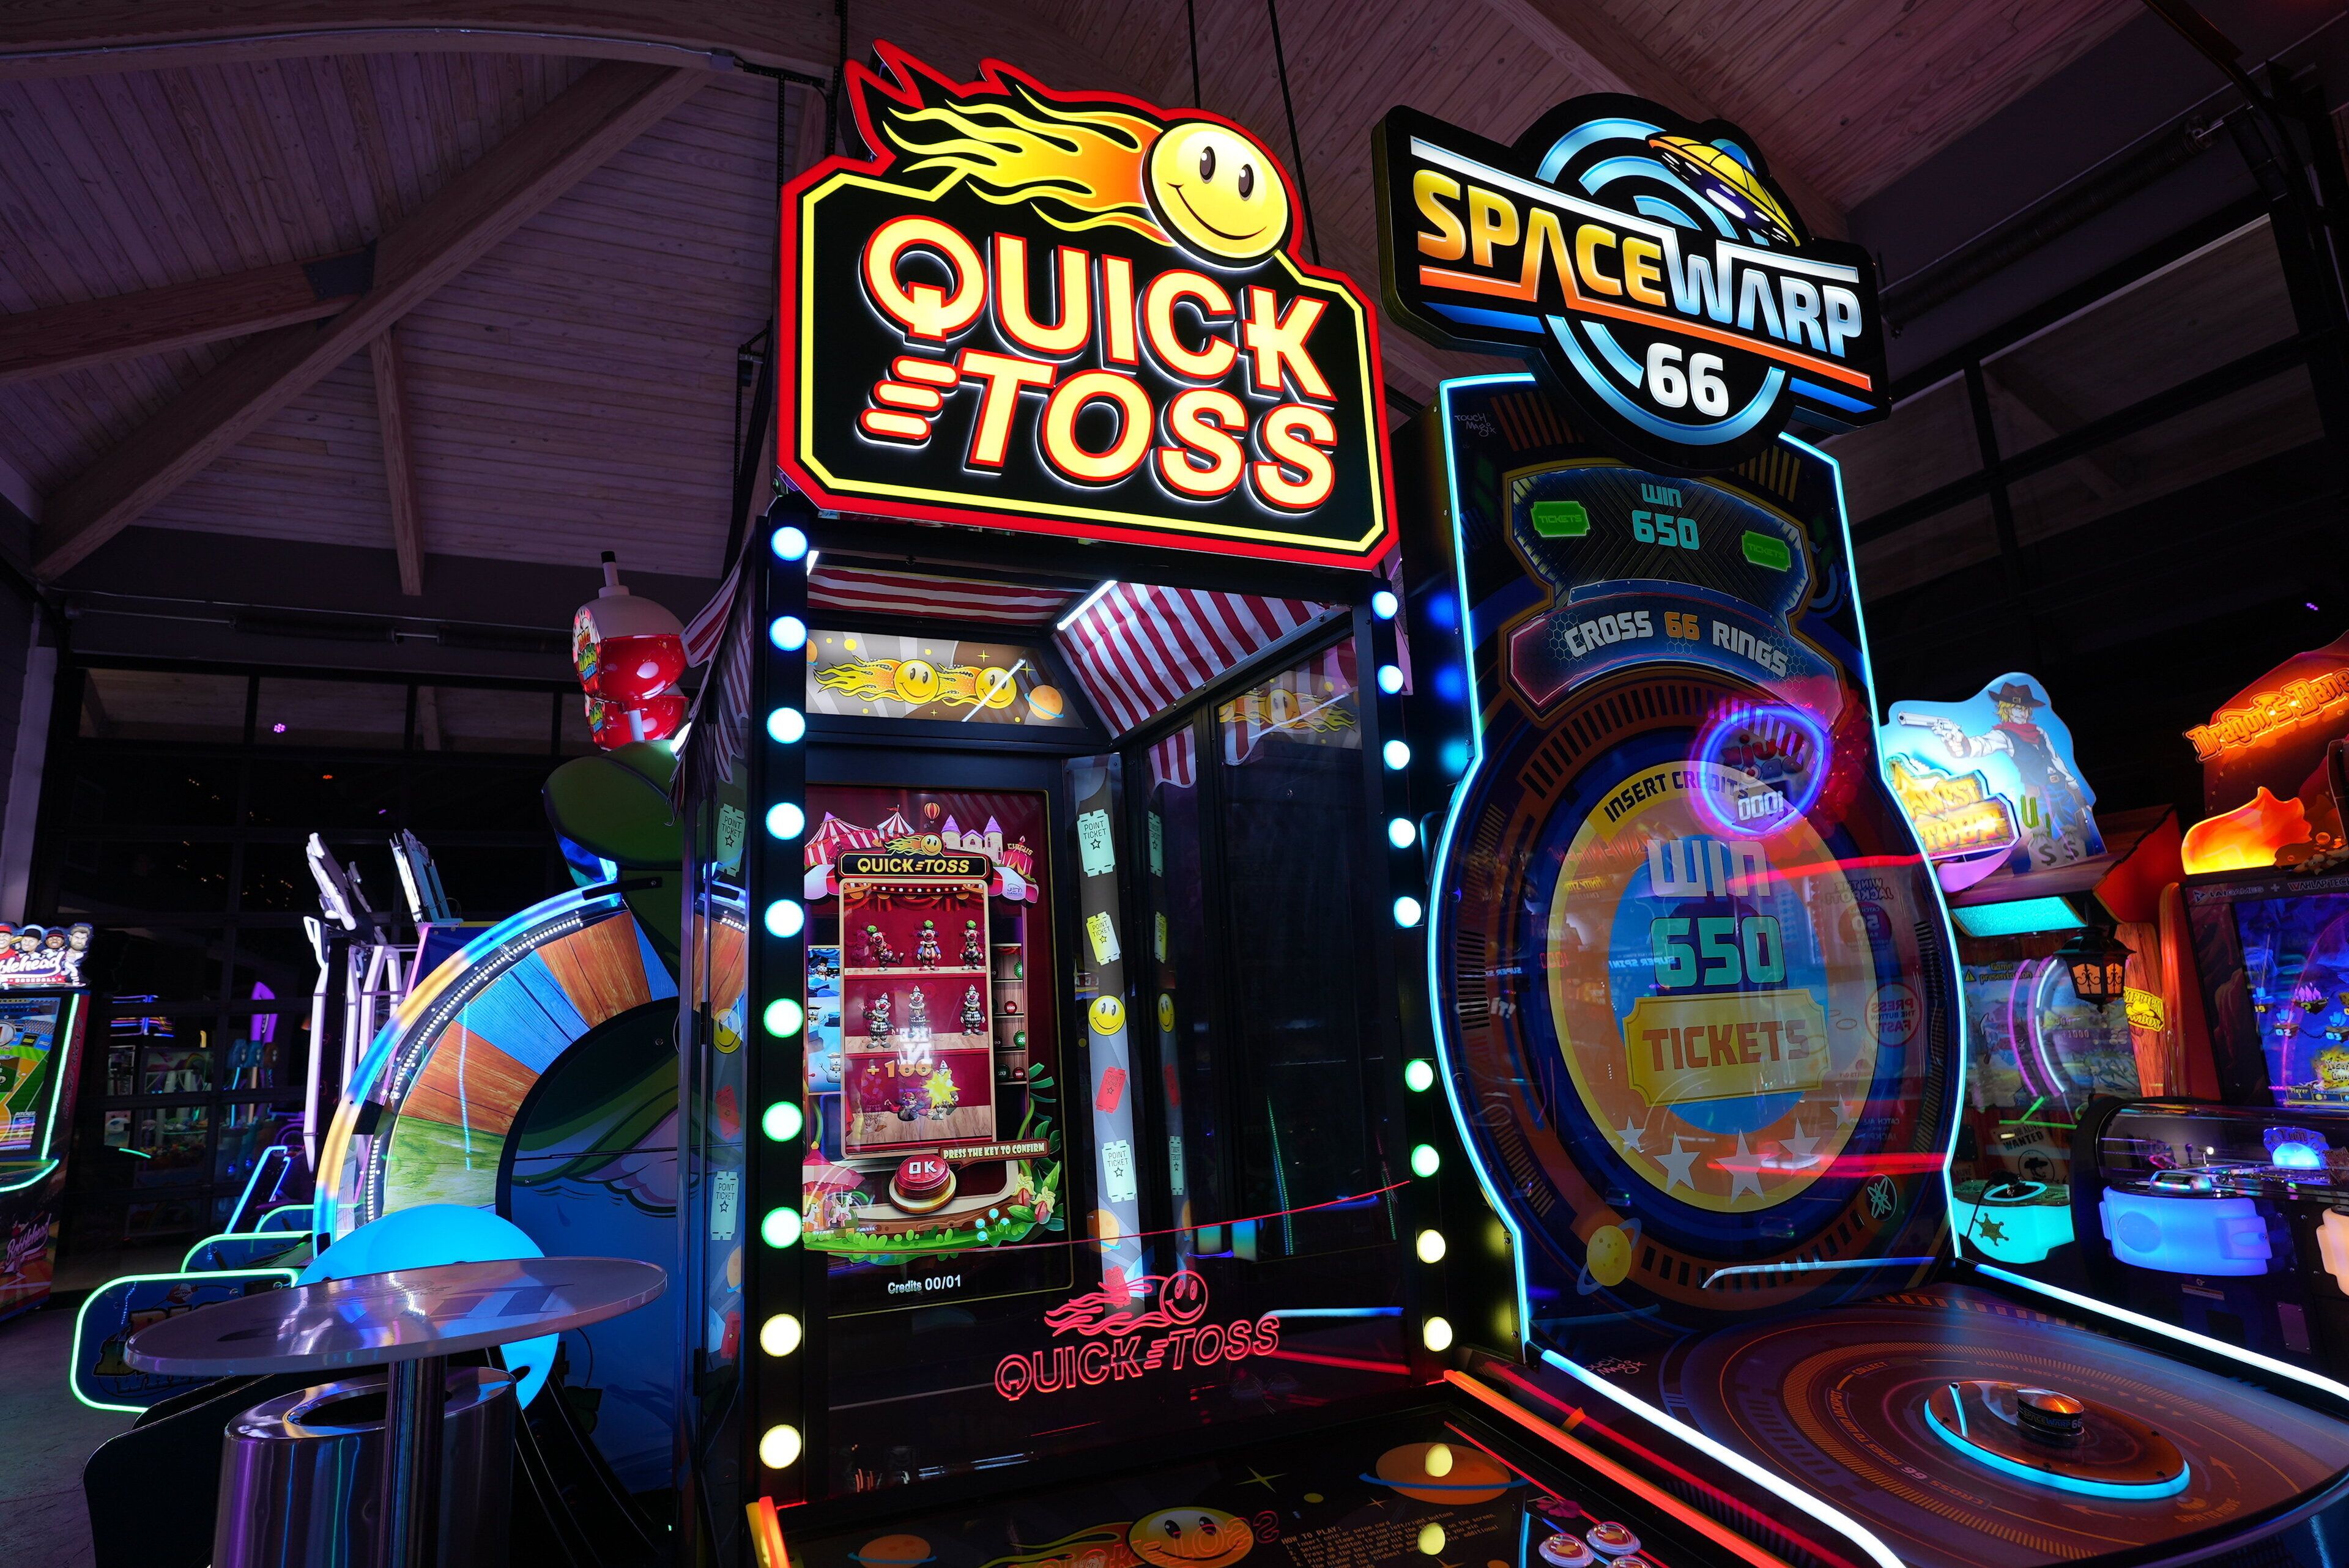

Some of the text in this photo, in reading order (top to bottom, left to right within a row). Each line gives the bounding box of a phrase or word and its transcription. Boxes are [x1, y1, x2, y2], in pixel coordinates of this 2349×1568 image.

[861, 214, 1338, 404] QUICK
[1647, 342, 1729, 416] 66
[954, 349, 1338, 512] TOSS
[1641, 483, 1682, 508] WIN
[1538, 514, 1582, 524] TICKETS
[1631, 509, 1699, 550] 650
[1564, 611, 1788, 678] CROSS 66 RINGS
[2185, 696, 2295, 760] Dragon's
[1604, 771, 1749, 823] INSERT CREDITS
[722, 823, 742, 838] TICKET
[724, 816, 742, 829] POINT
[1084, 820, 1104, 831] POINT
[1083, 828, 1106, 840] TICKET
[858, 857, 970, 873] QUICK TOSS
[1646, 840, 1772, 898] WIN
[1092, 920, 1108, 931] POINT
[1092, 926, 1110, 937] TICKET
[1650, 915, 1786, 988] 650
[1642, 1018, 1811, 1072] TICKETS
[2003, 1131, 2044, 1151] WANTED
[943, 1142, 1045, 1160] PRESS THE KEY TO CONFIRM
[1108, 1150, 1126, 1159] POINT
[909, 1161, 937, 1175] OK
[1107, 1158, 1128, 1167] TICKET
[716, 1192, 735, 1200] TICKET
[888, 1274, 961, 1294] Credits 00/01
[994, 1314, 1280, 1401] QUICK TOSS
[1976, 1361, 2019, 1371] AVOID
[1852, 1361, 1888, 1375] COLLECT
[1840, 1418, 1859, 1432] WIN
[1852, 1430, 1869, 1443] TO
[1866, 1443, 1903, 1465] RINGS
[1901, 1467, 1928, 1480] 66
[1931, 1480, 1985, 1505] CROSS
[1281, 1536, 1298, 1545] HOW
[1316, 1526, 1342, 1536] PLAY:
